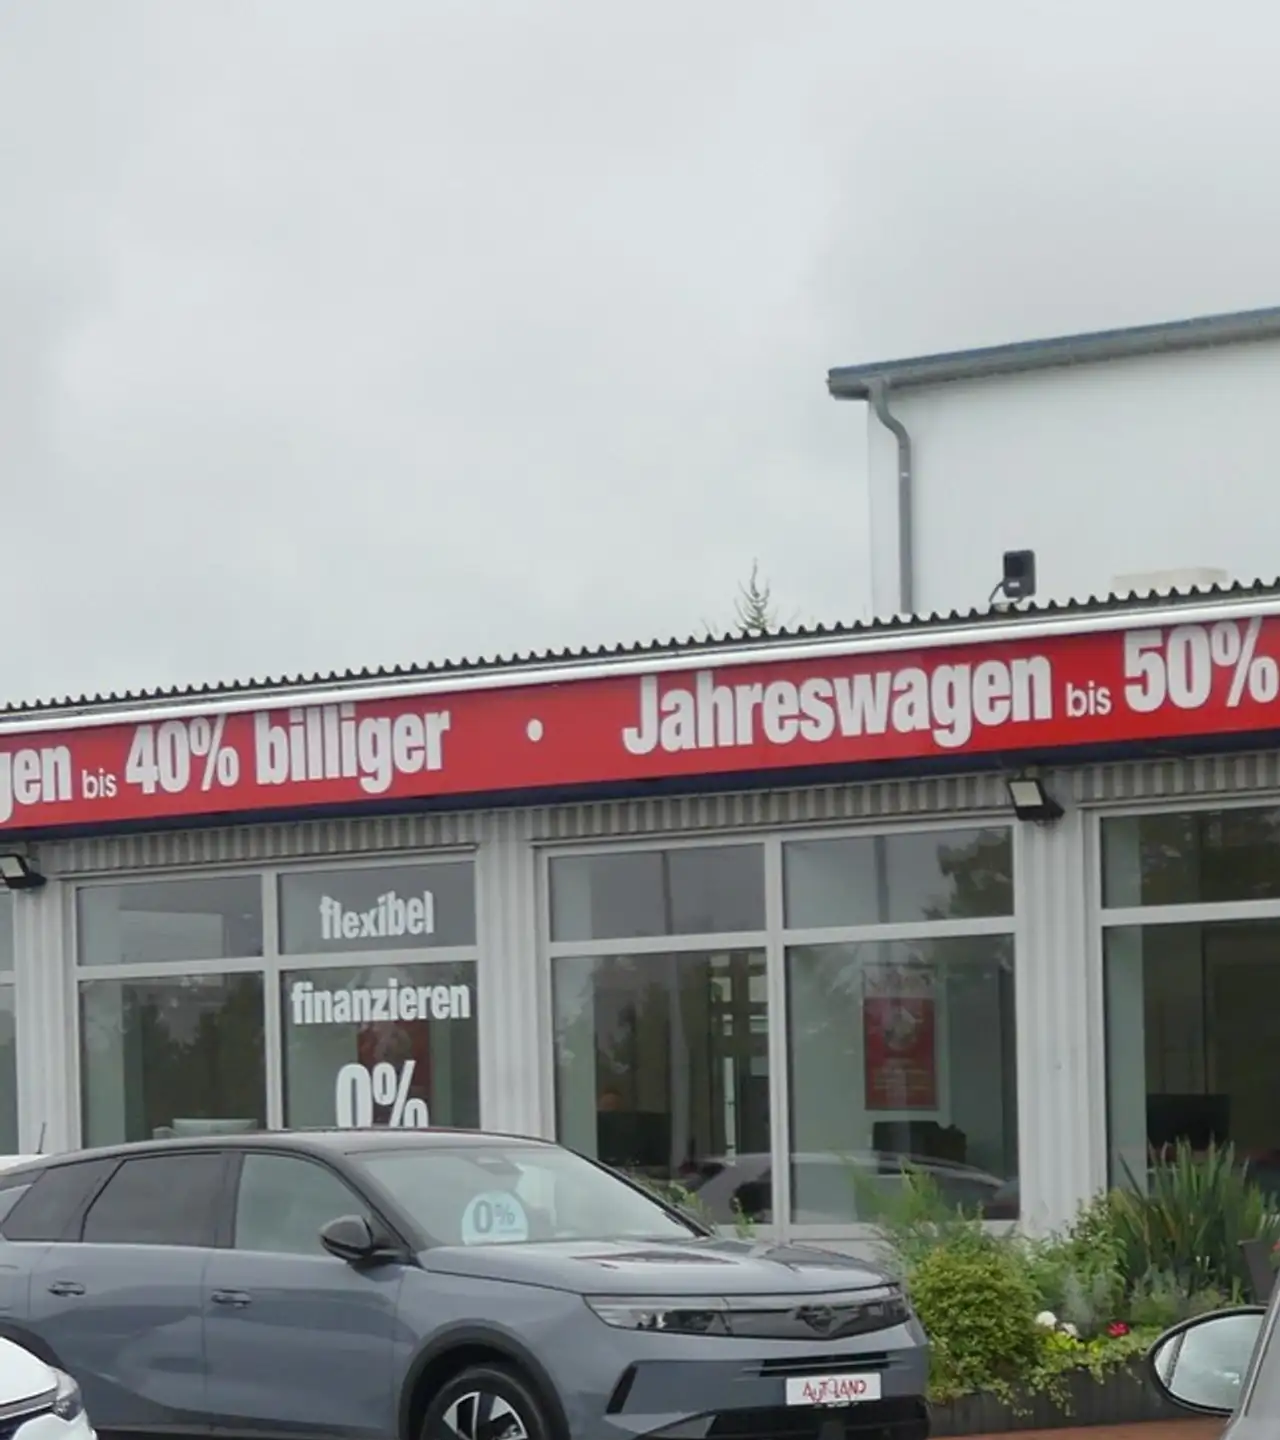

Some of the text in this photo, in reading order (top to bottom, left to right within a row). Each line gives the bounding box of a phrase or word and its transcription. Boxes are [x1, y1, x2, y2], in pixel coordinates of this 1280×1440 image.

[82, 768, 118, 799] bis
[125, 713, 240, 795] 40%
[254, 702, 451, 795] billiger
[622, 654, 1053, 756] Jahreswagen
[1065, 680, 1112, 719] bis
[1123, 616, 1280, 713] 50%
[319, 890, 435, 940] flexibel
[291, 977, 471, 1025] finanzieren
[335, 1059, 430, 1128] 0%
[472, 1199, 516, 1234] 0%
